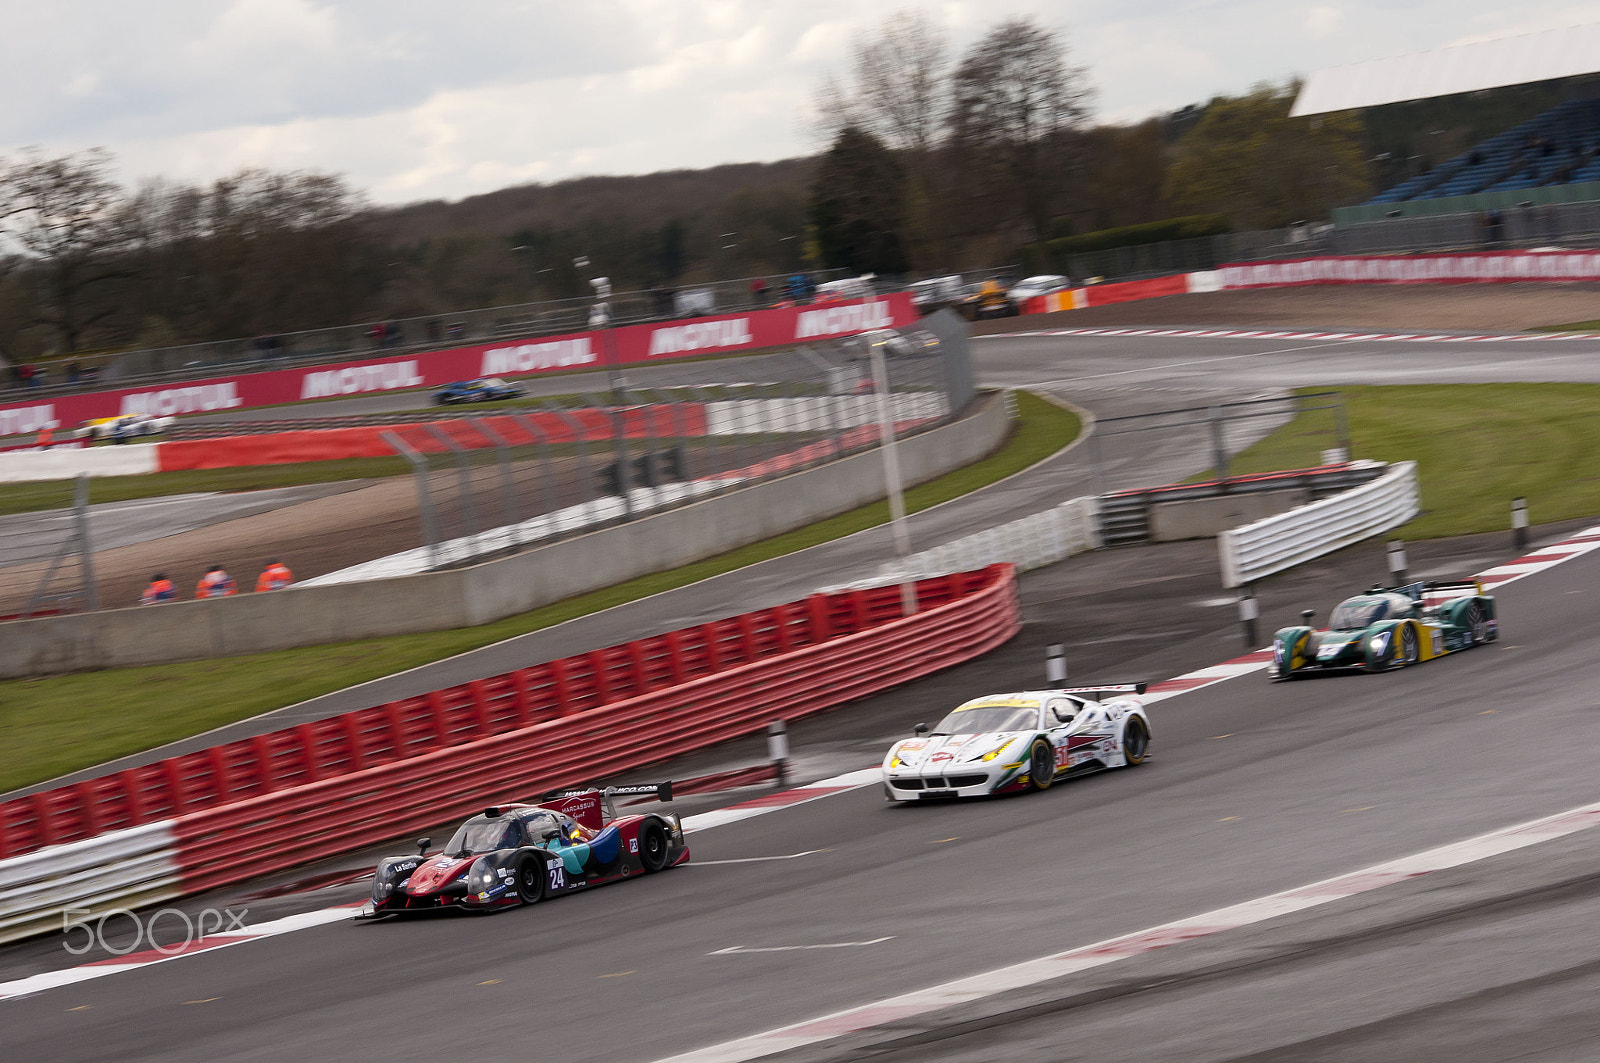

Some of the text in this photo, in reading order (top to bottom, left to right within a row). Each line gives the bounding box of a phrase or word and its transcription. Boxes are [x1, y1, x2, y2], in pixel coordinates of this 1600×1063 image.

[648, 318, 753, 356] MOTUL
[795, 301, 894, 338] MOTUL
[480, 337, 597, 376] MOTUL
[302, 360, 424, 399] MOTUL
[120, 381, 243, 416] MOTUL
[561, 801, 595, 814] MARCASSUS
[550, 867, 564, 890] 24
